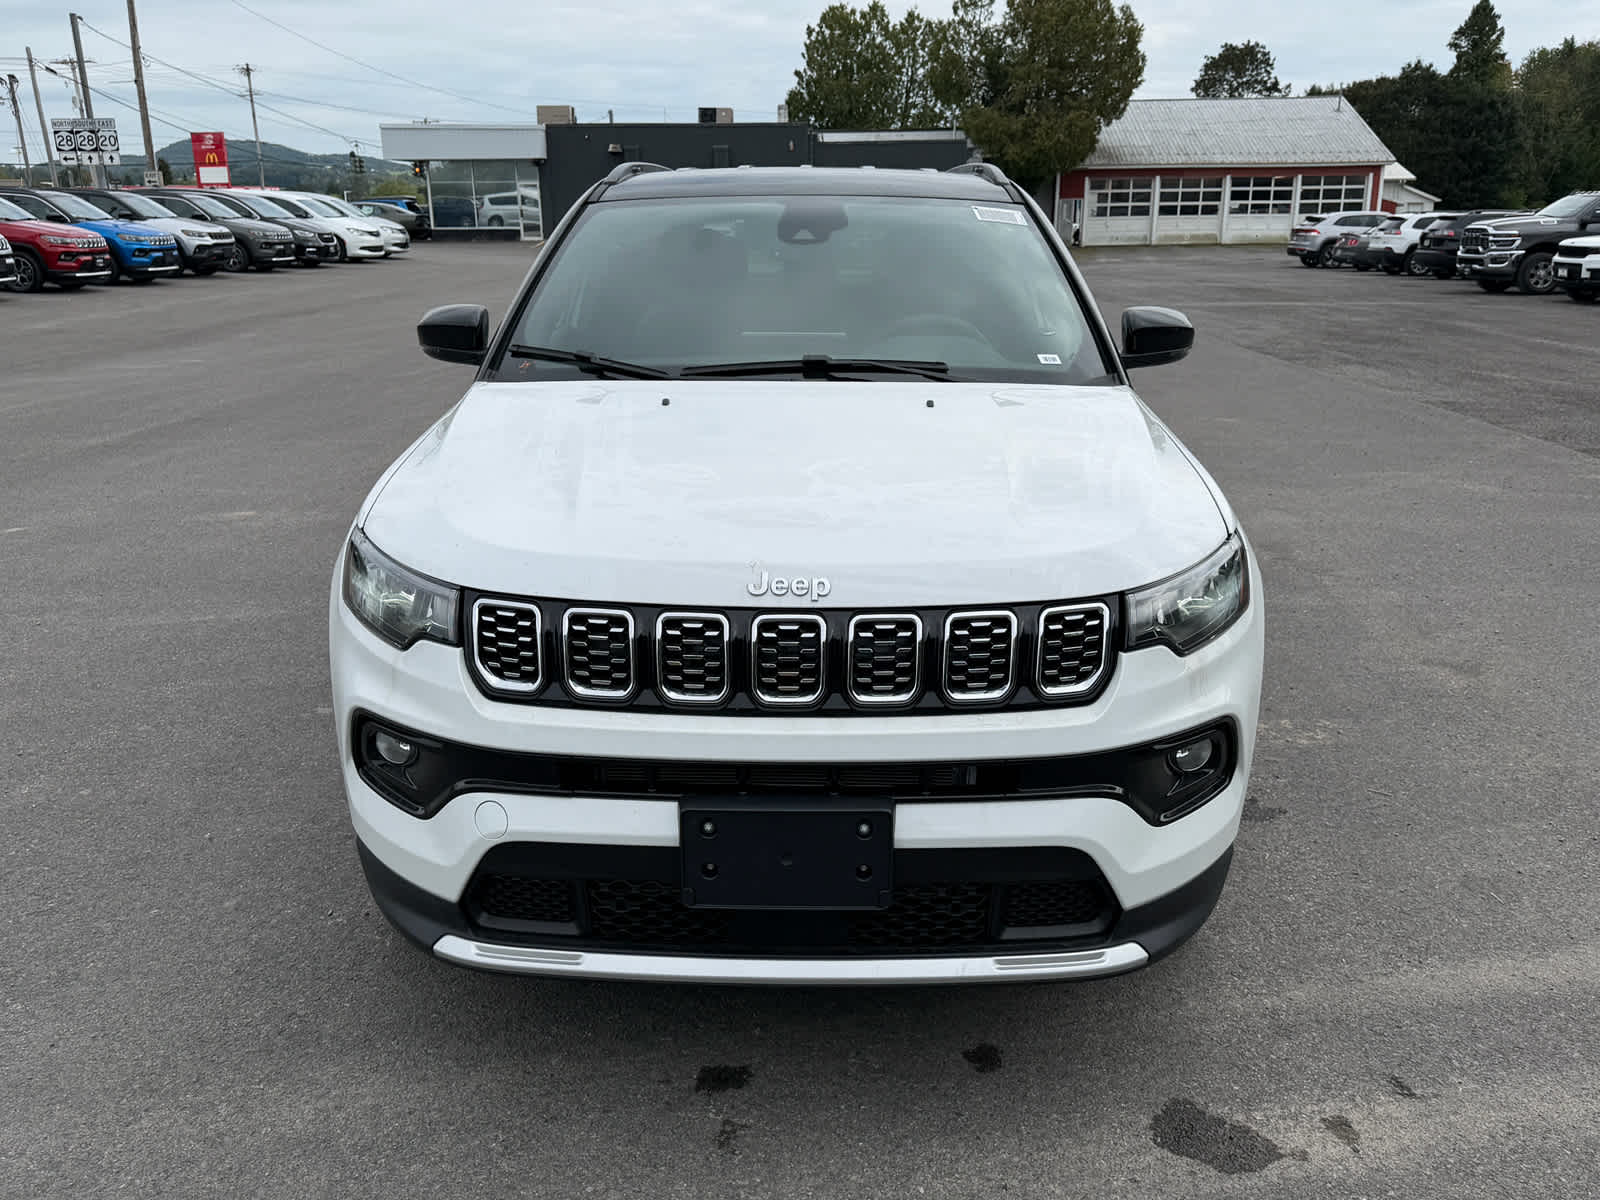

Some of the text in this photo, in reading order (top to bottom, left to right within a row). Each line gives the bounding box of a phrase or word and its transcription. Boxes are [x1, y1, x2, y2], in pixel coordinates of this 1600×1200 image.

[57, 135, 74, 147] 28
[78, 135, 95, 147] 28
[99, 135, 117, 147] 20
[747, 567, 831, 602] Jeep
